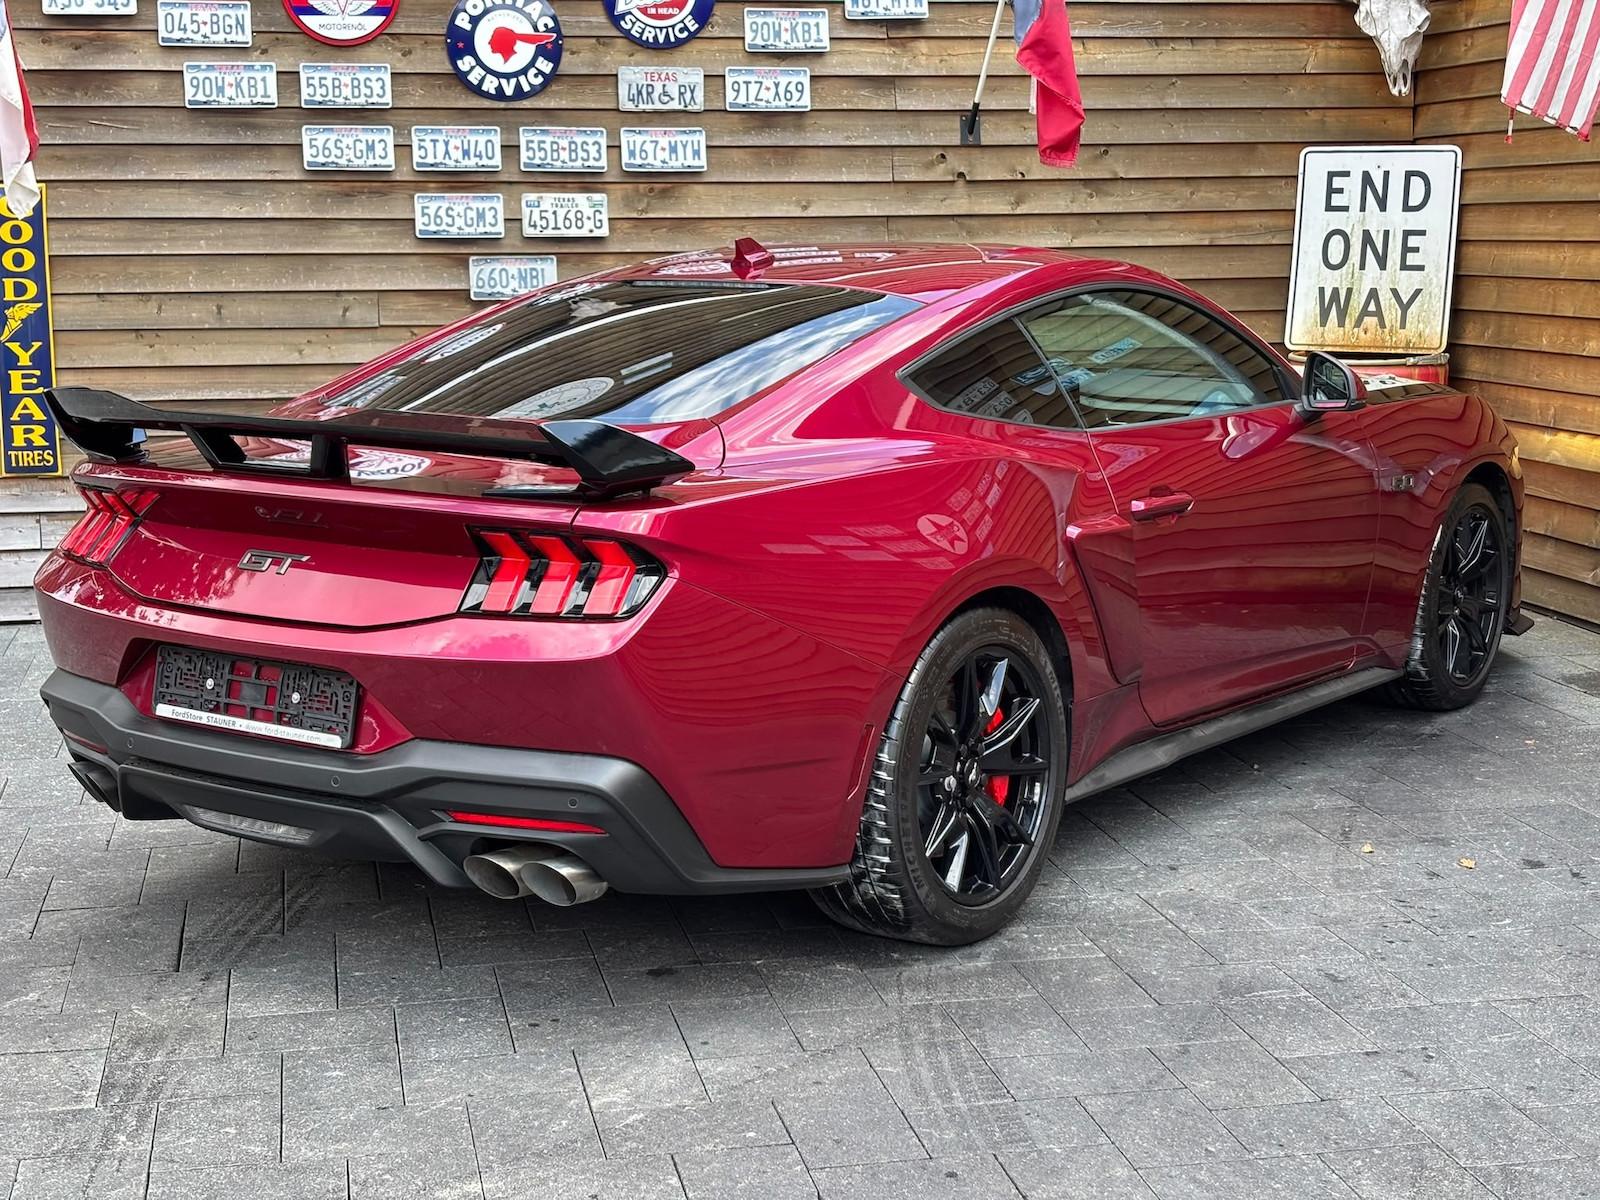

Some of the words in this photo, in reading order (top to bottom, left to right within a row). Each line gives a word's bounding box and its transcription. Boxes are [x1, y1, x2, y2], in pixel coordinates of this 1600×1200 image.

[658, 7, 680, 15] HEAD
[164, 12, 201, 35] 045
[210, 13, 245, 36] BGN
[318, 22, 368, 31] MOTORENÖL
[620, 14, 700, 44] SERVICE
[790, 21, 824, 43] KB1
[235, 76, 271, 98] KB1
[456, 55, 555, 97] SERVICE
[643, 71, 678, 82] TEXAS
[306, 76, 342, 98] 55B
[351, 77, 386, 99] BS3
[627, 83, 655, 105] 4KR
[678, 84, 697, 106] RX
[731, 81, 763, 102] 9TZ
[773, 81, 804, 102] X69
[309, 138, 344, 159] 56S
[353, 139, 388, 160] GM3
[417, 139, 452, 160] 5TX
[525, 139, 560, 162] 55B
[568, 140, 602, 162] BS3
[627, 140, 659, 161] W67
[668, 140, 701, 161] MYW
[1324, 170, 1431, 213] END
[421, 206, 455, 228] 56S
[464, 206, 498, 228] GM3
[528, 209, 585, 231] 45168
[593, 209, 604, 230] G
[1321, 229, 1427, 271] ONE
[1318, 287, 1423, 329] WAY
[8, 451, 54, 467] TIRES
[237, 549, 312, 575] GT
[206, 715, 237, 728] STAUNER
